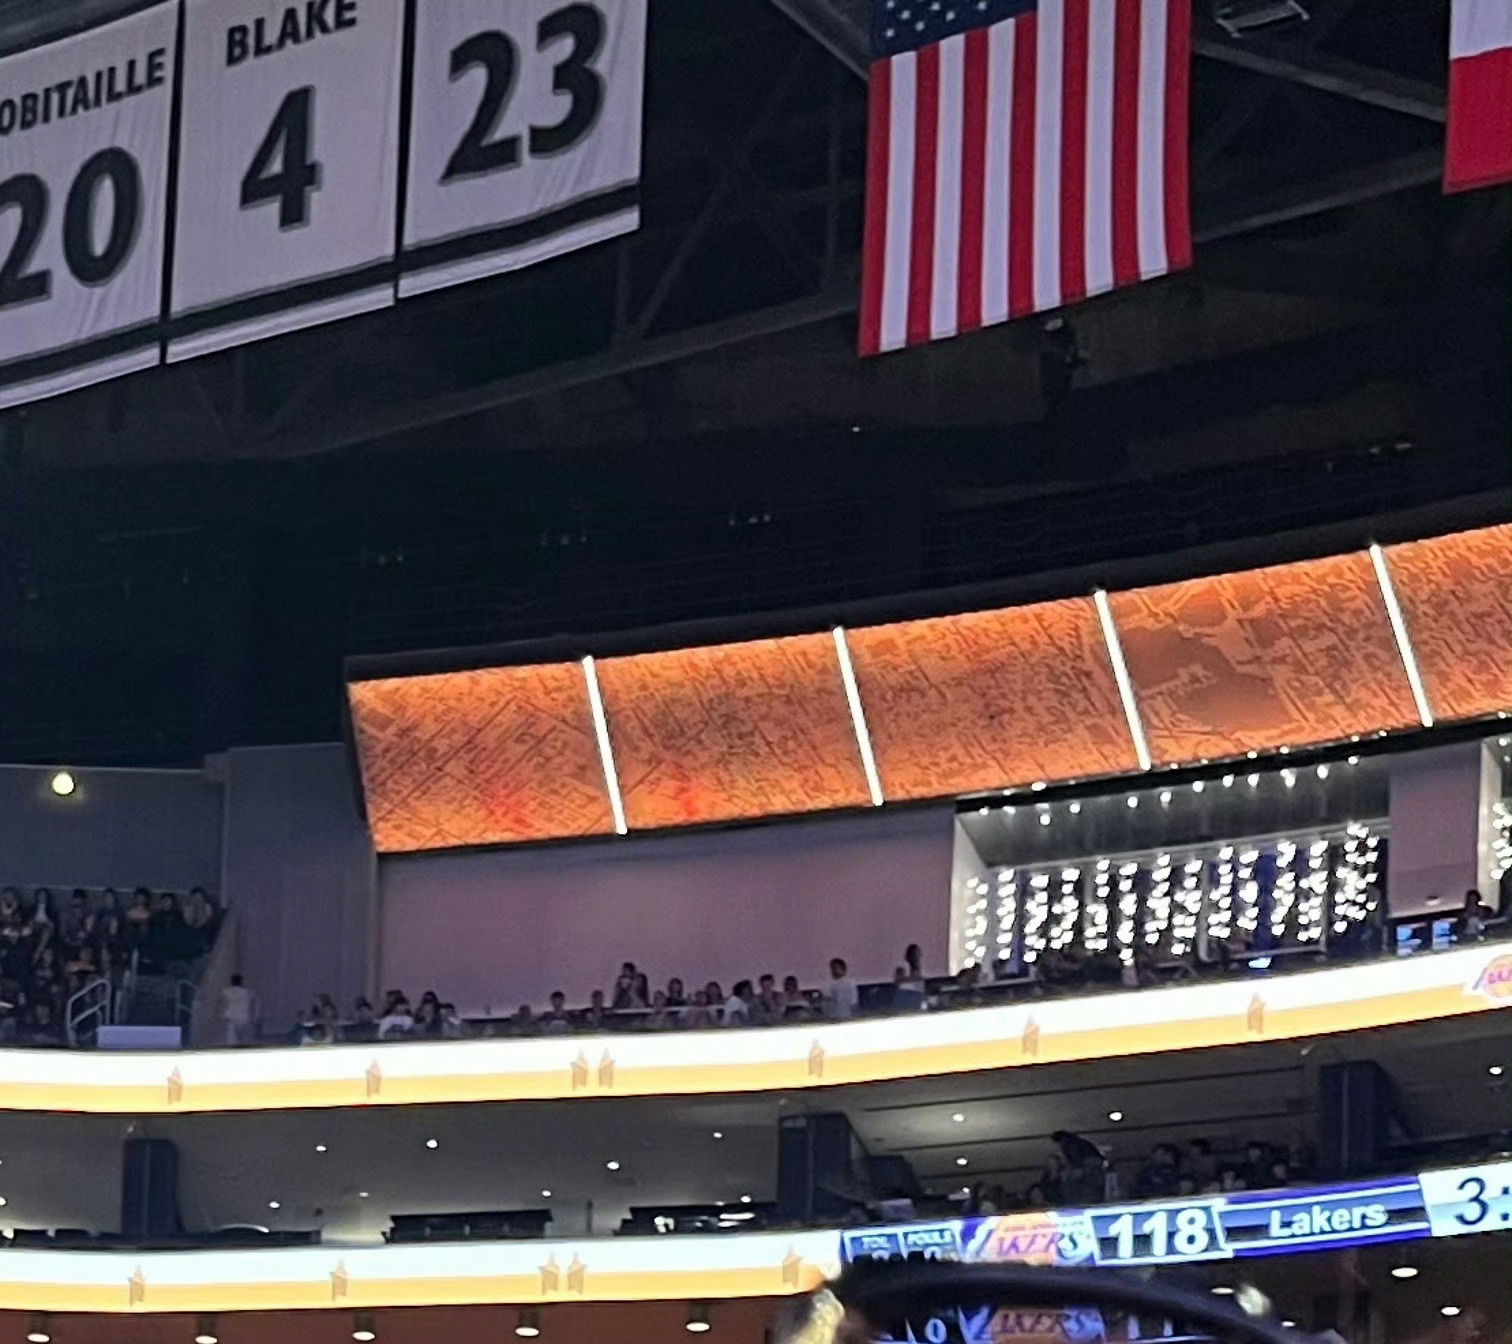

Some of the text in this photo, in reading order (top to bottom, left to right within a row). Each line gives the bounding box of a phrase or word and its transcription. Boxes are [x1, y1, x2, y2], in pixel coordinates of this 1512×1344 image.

[224, 0, 358, 68] BLAKE
[439, 3, 608, 187] 23
[239, 84, 322, 233] 4
[1108, 1208, 1209, 1258] 118
[1269, 1202, 1388, 1239] Lakers
